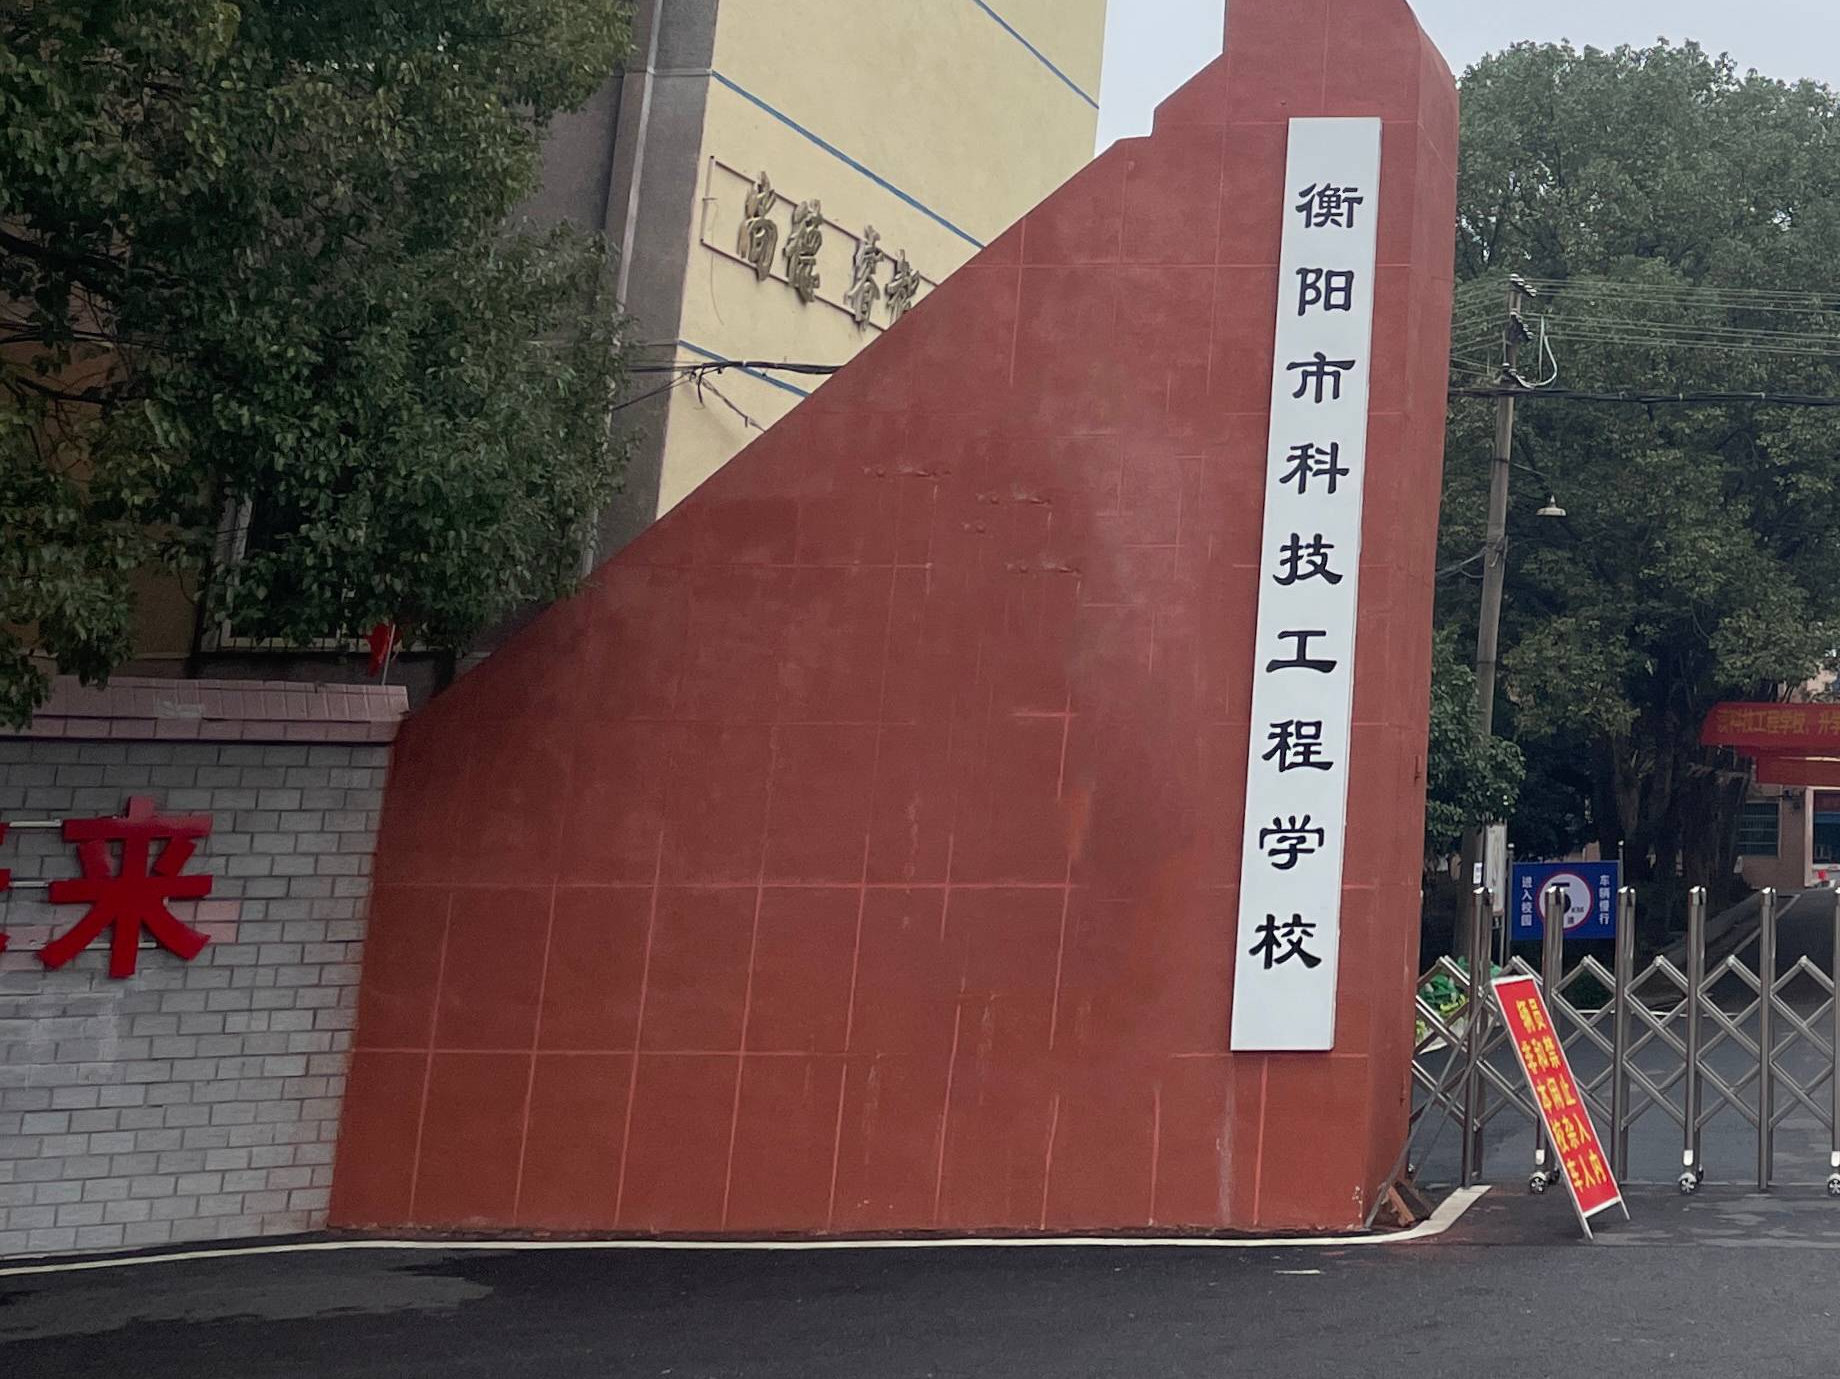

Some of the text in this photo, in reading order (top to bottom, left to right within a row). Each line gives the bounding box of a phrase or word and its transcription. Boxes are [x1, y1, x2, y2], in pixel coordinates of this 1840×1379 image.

[1248, 181, 1364, 972] 衡阳市科技工程学校
[0, 797, 214, 979] 来
[1521, 876, 1532, 927] 进入校园
[1598, 874, 1612, 926] 车辆慢行
